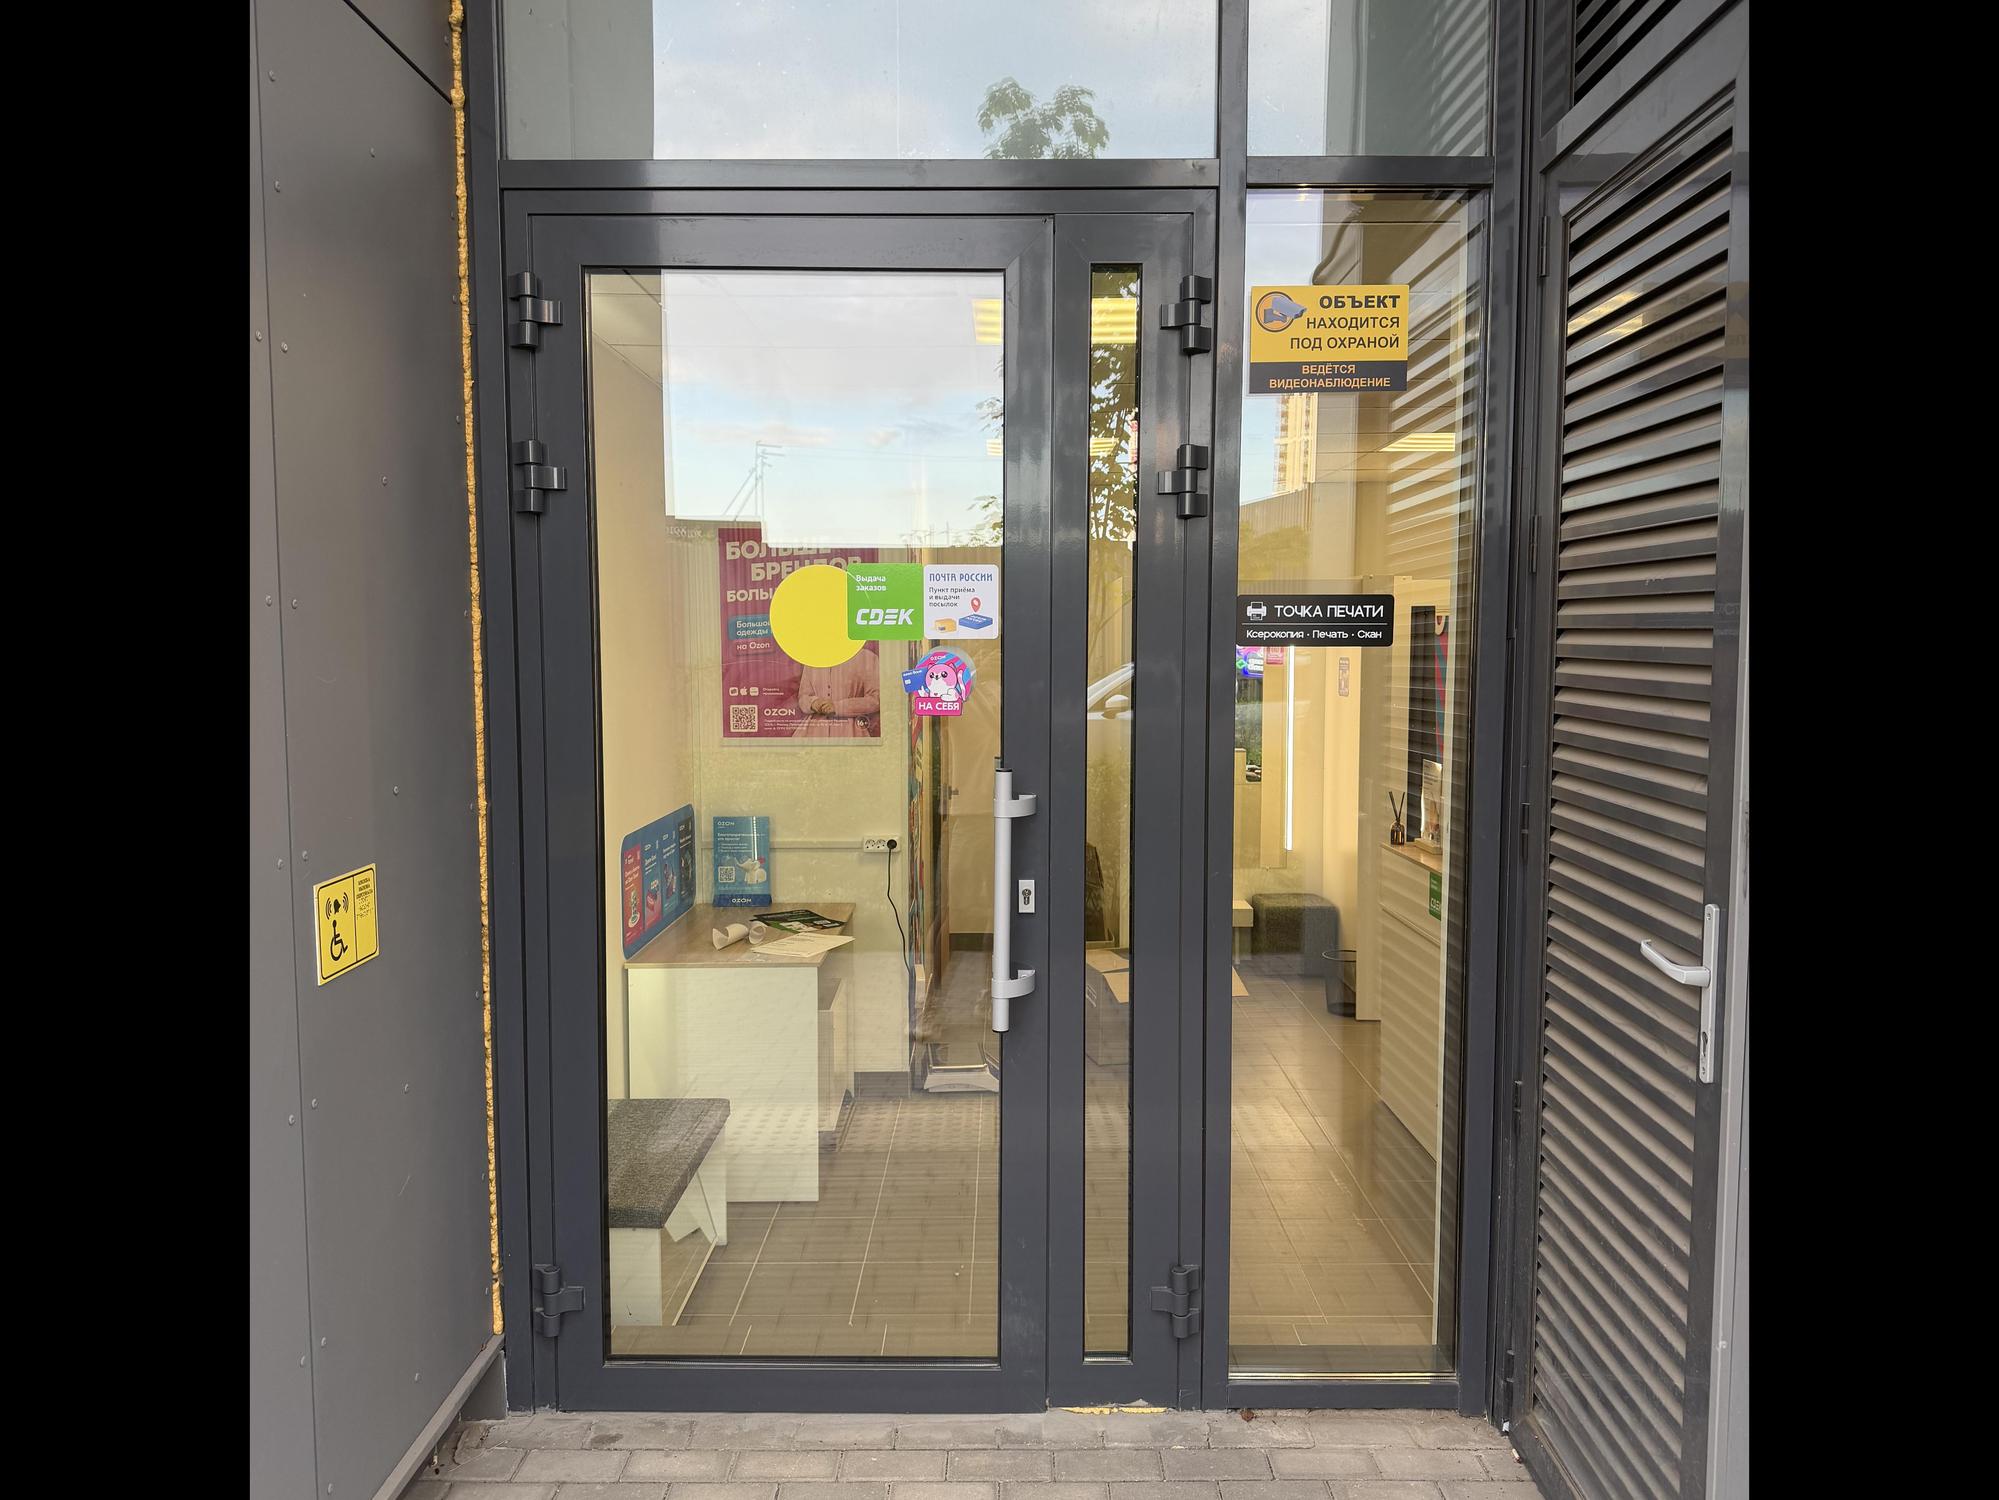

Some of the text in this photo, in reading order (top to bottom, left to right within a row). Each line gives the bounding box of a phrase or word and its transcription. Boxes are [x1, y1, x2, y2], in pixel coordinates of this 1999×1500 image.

[1319, 295, 1400, 309] ОБЪЕКТ
[1306, 316, 1400, 330] НАХОДИТСЯ
[1290, 334, 1399, 351] ПОД ОХРАНОЙ
[1302, 363, 1356, 376] ВЕДЁТСЯ
[1269, 377, 1391, 389] ВИДЕОНАБЛЮДЕНИЕ
[855, 574, 887, 583] Выдача
[929, 573, 993, 582] ПОЧТА РОССИИ
[950, 586, 976, 594] приёма
[856, 608, 914, 625] CDEK
[1274, 605, 1384, 618] ТОЧКА ПЕЧАТИ
[736, 628, 768, 636] одежды
[1246, 630, 1382, 640] Ксерокопия Печать Скан
[749, 641, 770, 649] Ozon
[918, 702, 960, 711] НА СЕБЯ
[763, 708, 796, 716] OZON
